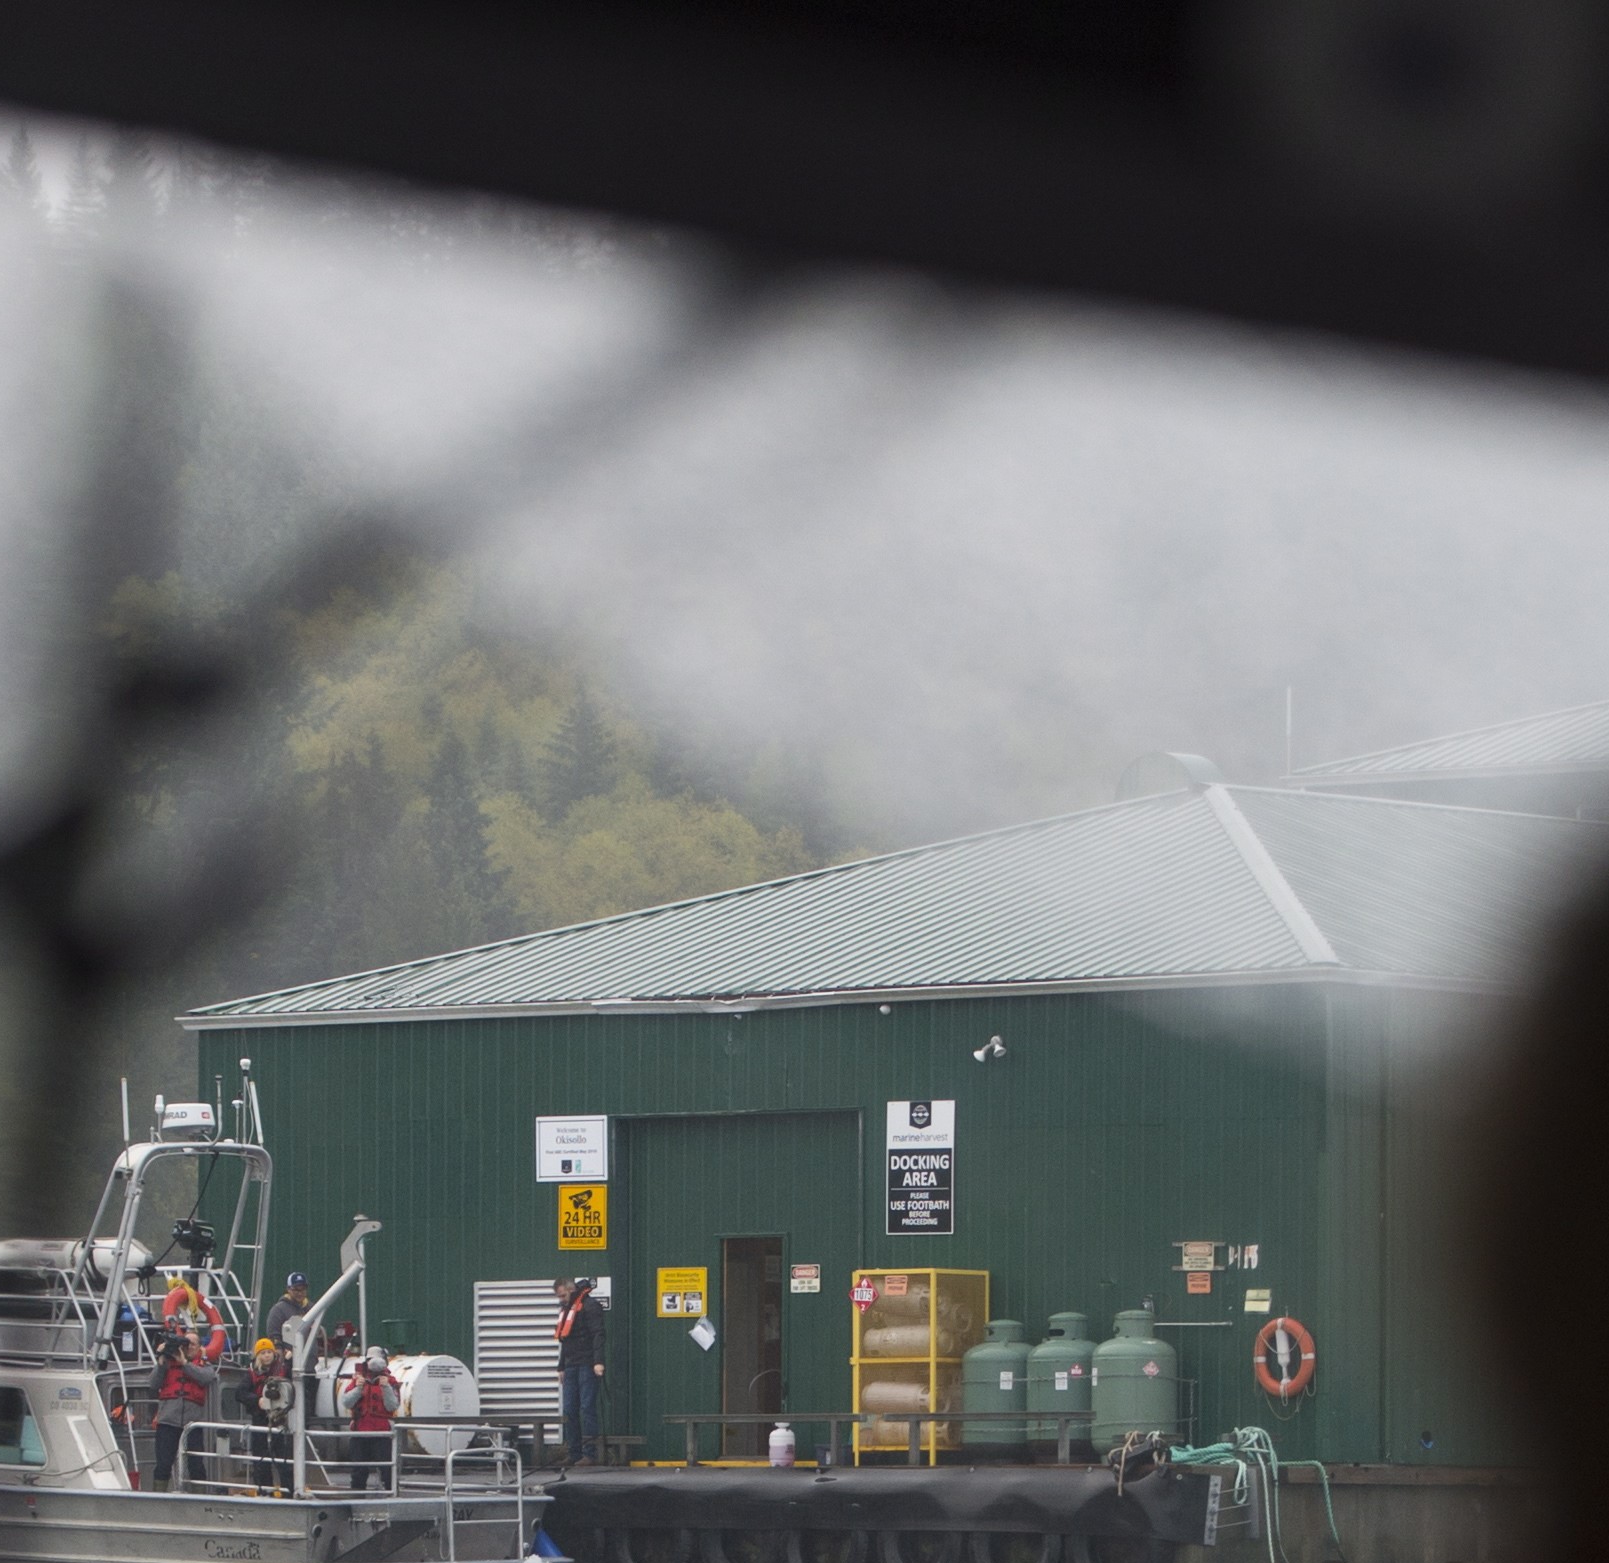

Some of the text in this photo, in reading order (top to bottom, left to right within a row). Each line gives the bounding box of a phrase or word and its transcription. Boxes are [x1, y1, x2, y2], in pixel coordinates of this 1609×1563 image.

[555, 1135, 587, 1145] Okisollo
[892, 1133, 949, 1142] marineharvest
[890, 1154, 950, 1171] DOCKING
[902, 1171, 938, 1187] AREA
[890, 1200, 950, 1211] USE FOOTBATH
[564, 1211, 601, 1225] 24 HR
[902, 1218, 938, 1226] PROCEEDING
[566, 1227, 599, 1237] VIDEO
[855, 1289, 872, 1300] 1075
[204, 1539, 262, 1561] Canada
